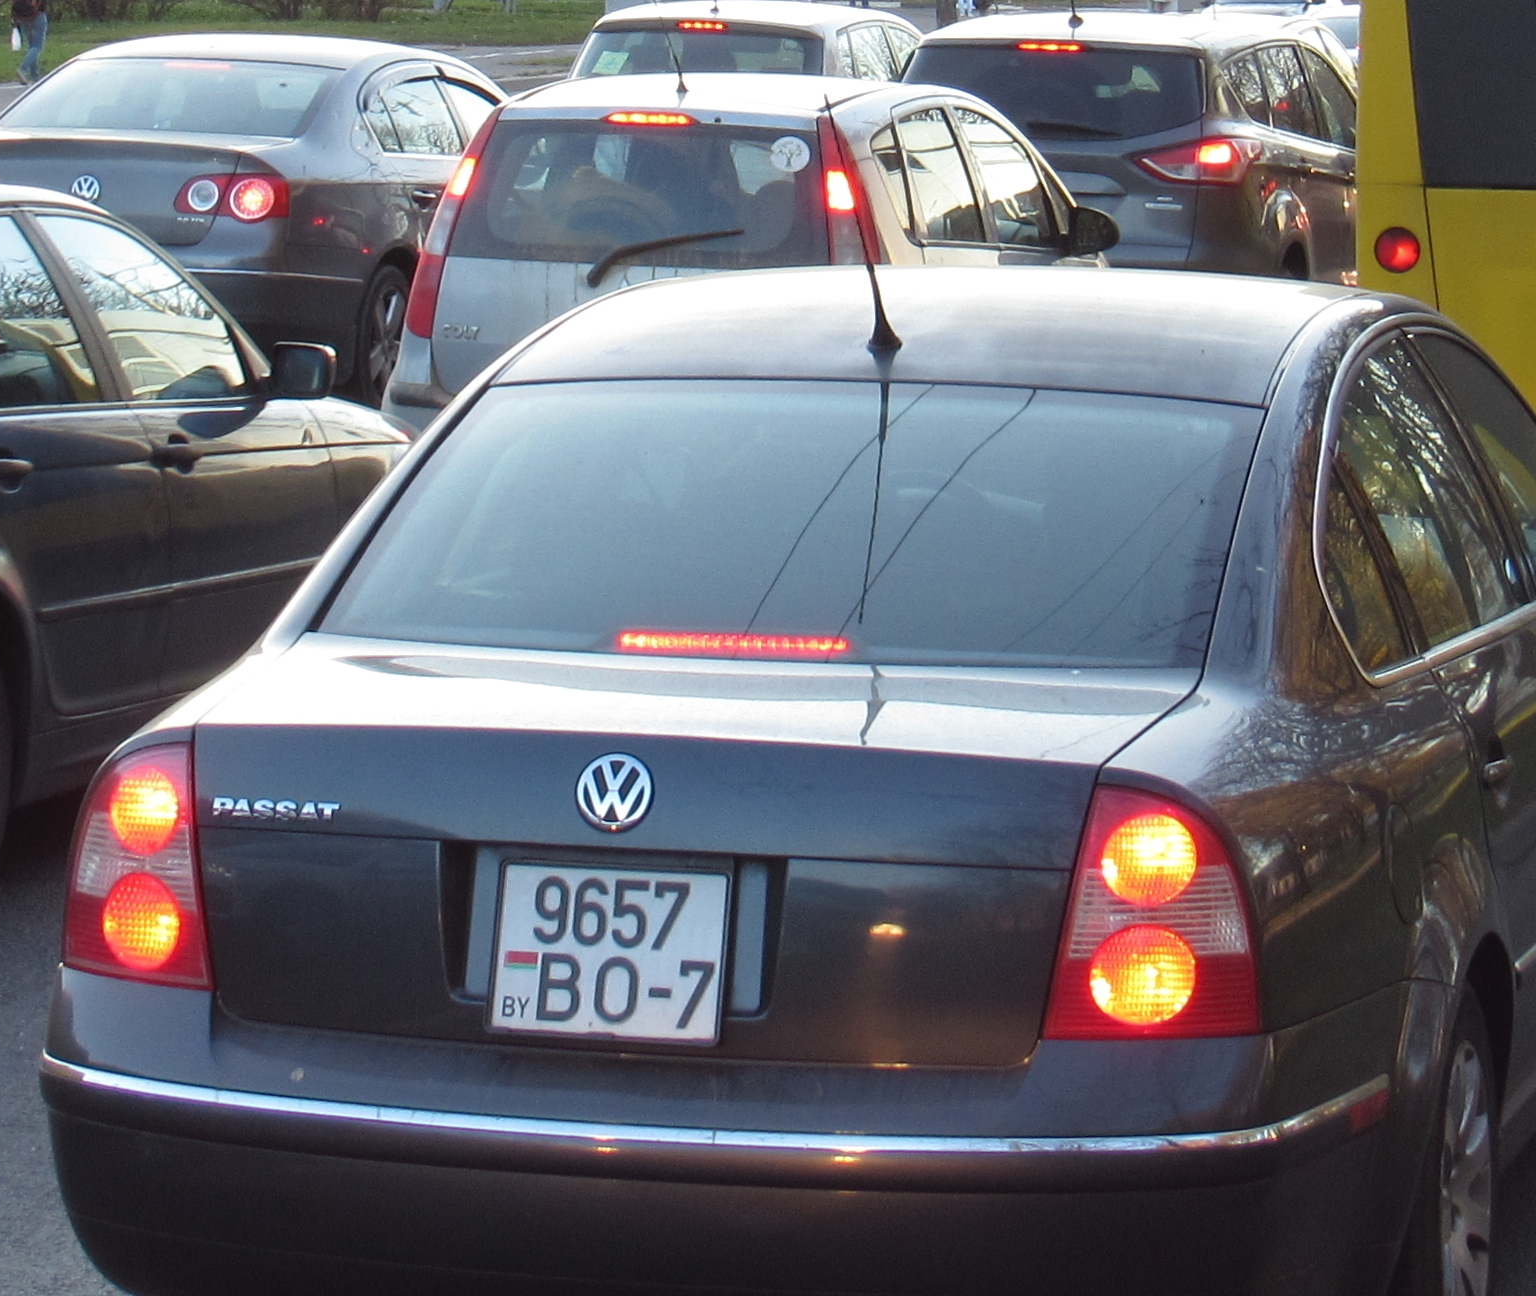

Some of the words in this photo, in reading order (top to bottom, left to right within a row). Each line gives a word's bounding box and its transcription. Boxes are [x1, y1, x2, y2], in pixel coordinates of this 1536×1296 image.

[443, 324, 480, 341] COLT
[212, 796, 341, 821] PASSAT
[533, 875, 691, 952] 9657
[536, 952, 716, 1030] BO-7
[501, 995, 531, 1019] BY
